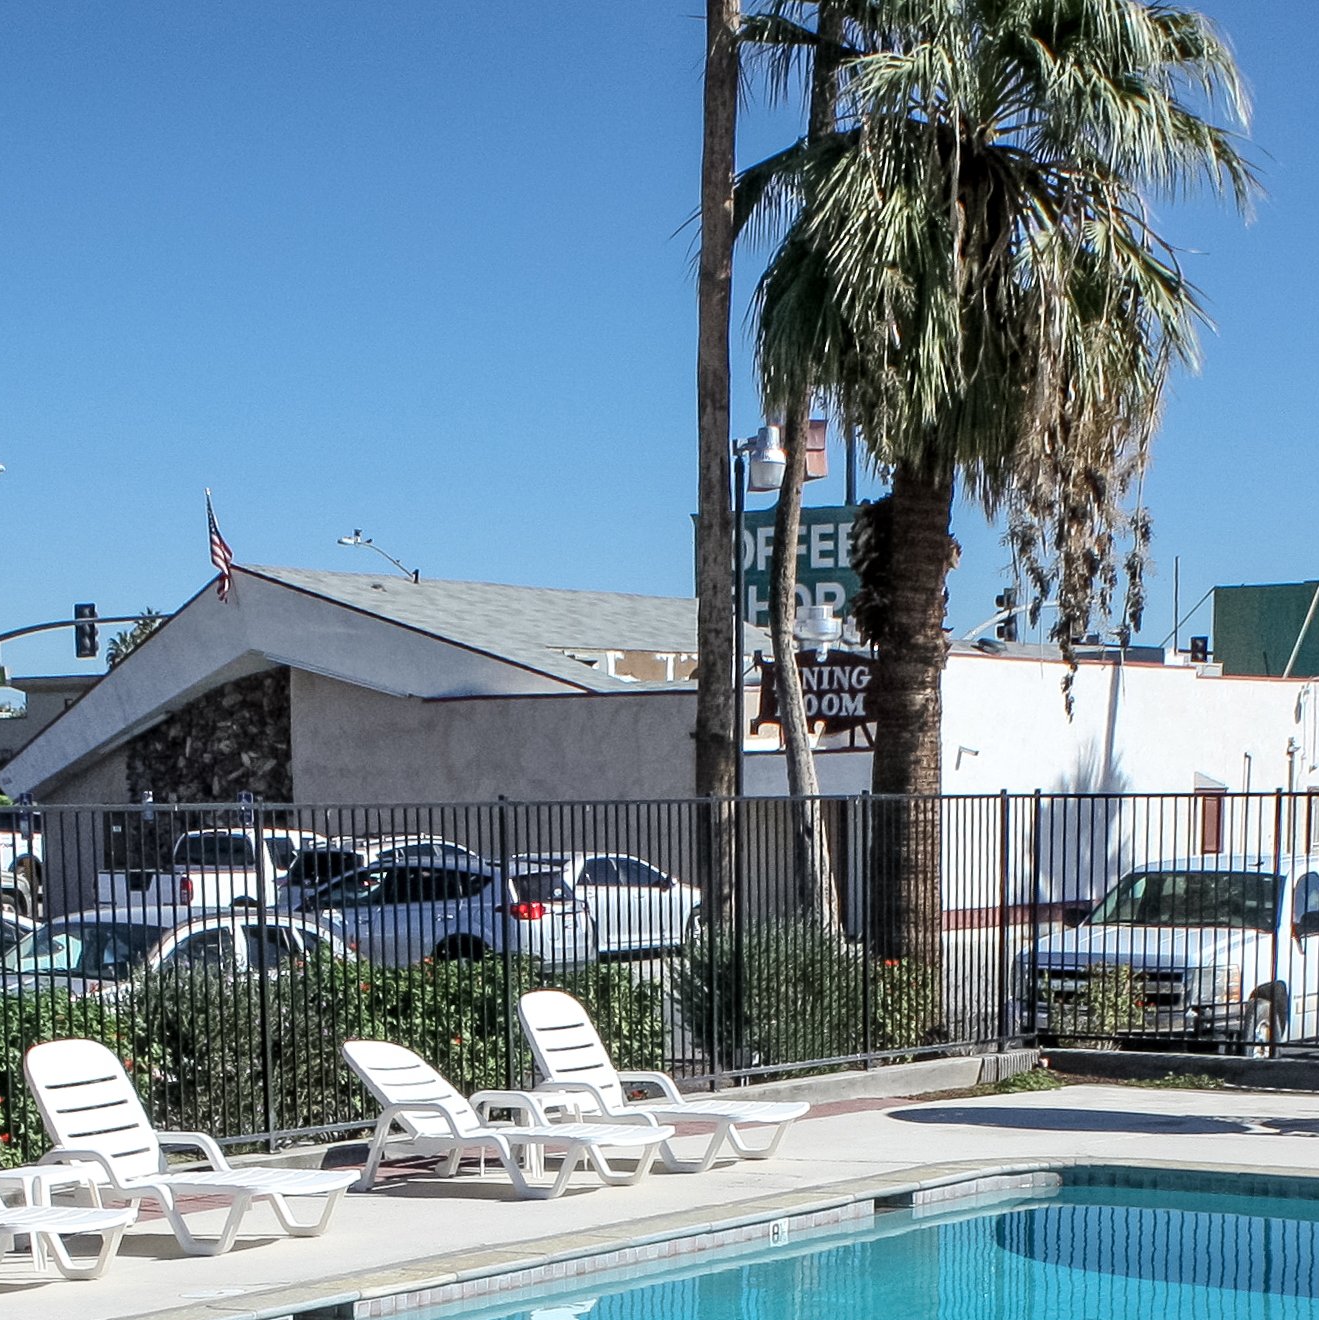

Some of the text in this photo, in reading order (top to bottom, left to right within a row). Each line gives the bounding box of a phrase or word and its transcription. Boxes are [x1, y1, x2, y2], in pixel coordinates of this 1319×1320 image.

[732, 523, 854, 571] OFEE
[773, 666, 872, 691] NING
[775, 693, 866, 716] OOM
